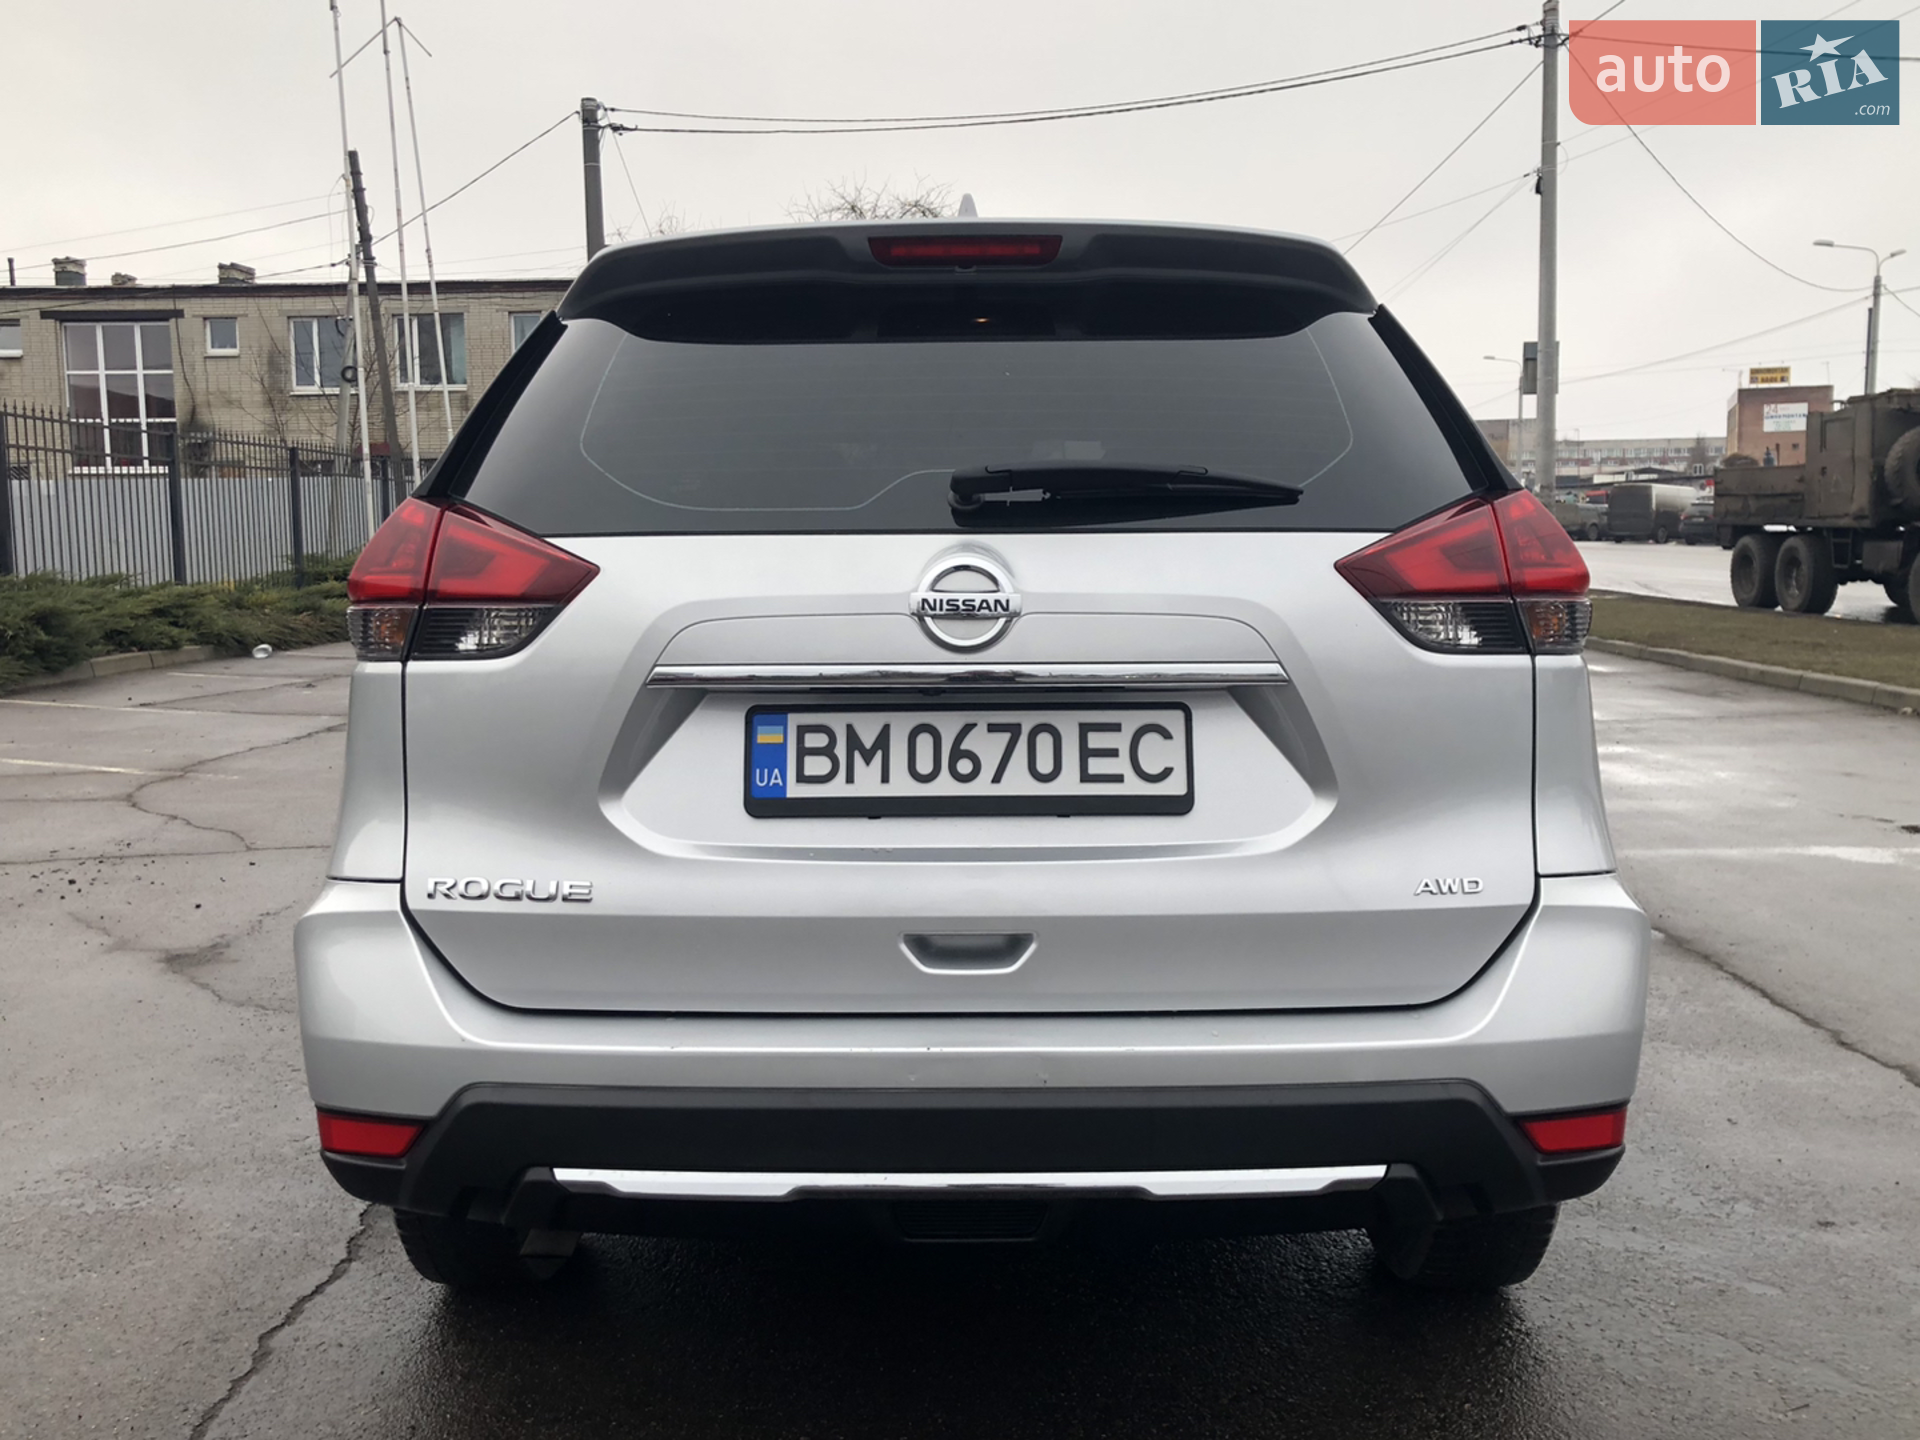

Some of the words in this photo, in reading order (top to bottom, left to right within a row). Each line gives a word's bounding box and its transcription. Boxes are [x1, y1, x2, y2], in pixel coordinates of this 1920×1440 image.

[920, 597, 1010, 613] NISSAN
[795, 723, 892, 785] BM
[907, 722, 1063, 784] 0670
[1077, 722, 1175, 784] EC
[755, 767, 783, 787] UA
[426, 876, 594, 904] ROGUE
[1413, 877, 1484, 897] AWD
